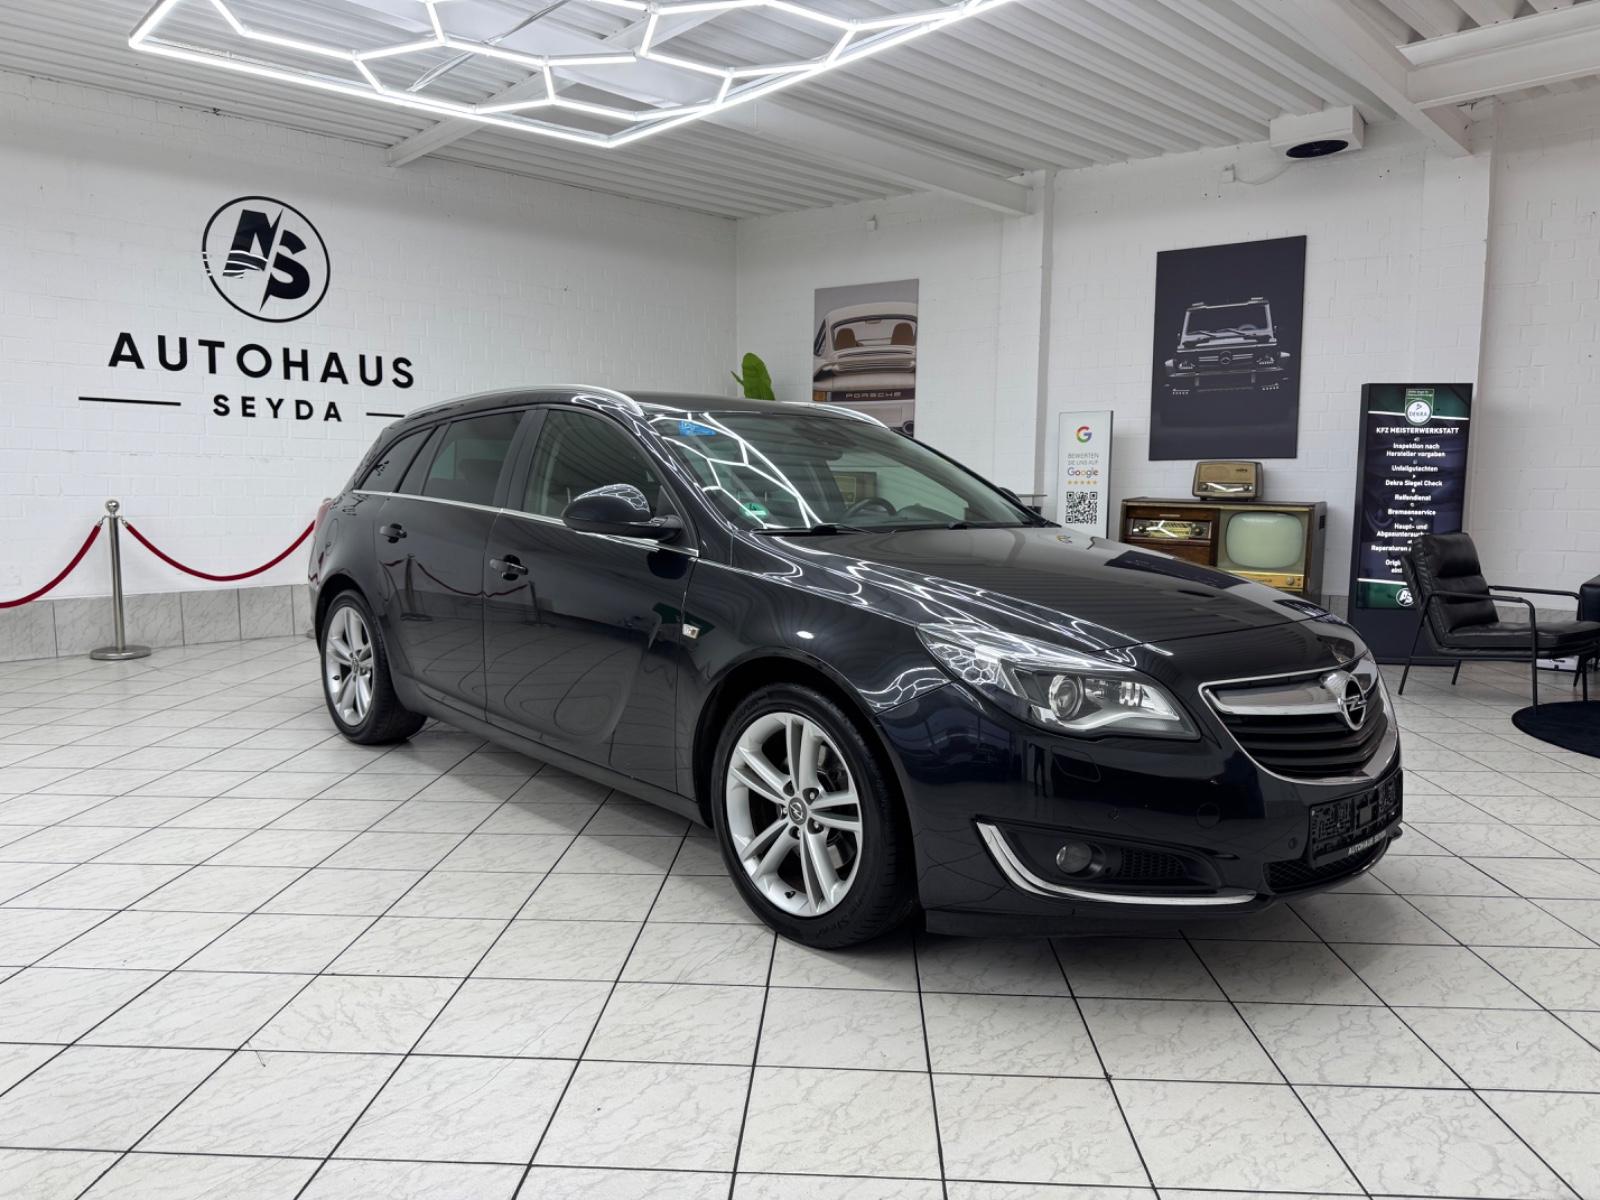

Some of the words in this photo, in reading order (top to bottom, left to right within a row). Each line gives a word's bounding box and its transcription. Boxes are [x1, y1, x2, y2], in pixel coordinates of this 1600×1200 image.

[108, 332, 415, 389] AUTOHAUS
[845, 391, 902, 399] PORSCHE
[212, 394, 342, 422] SEYDA
[1068, 467, 1099, 478] Google
[1392, 465, 1438, 473] Unfallgutachten
[1404, 480, 1423, 488] Siegel
[1388, 508, 1437, 516] Bremsenservice
